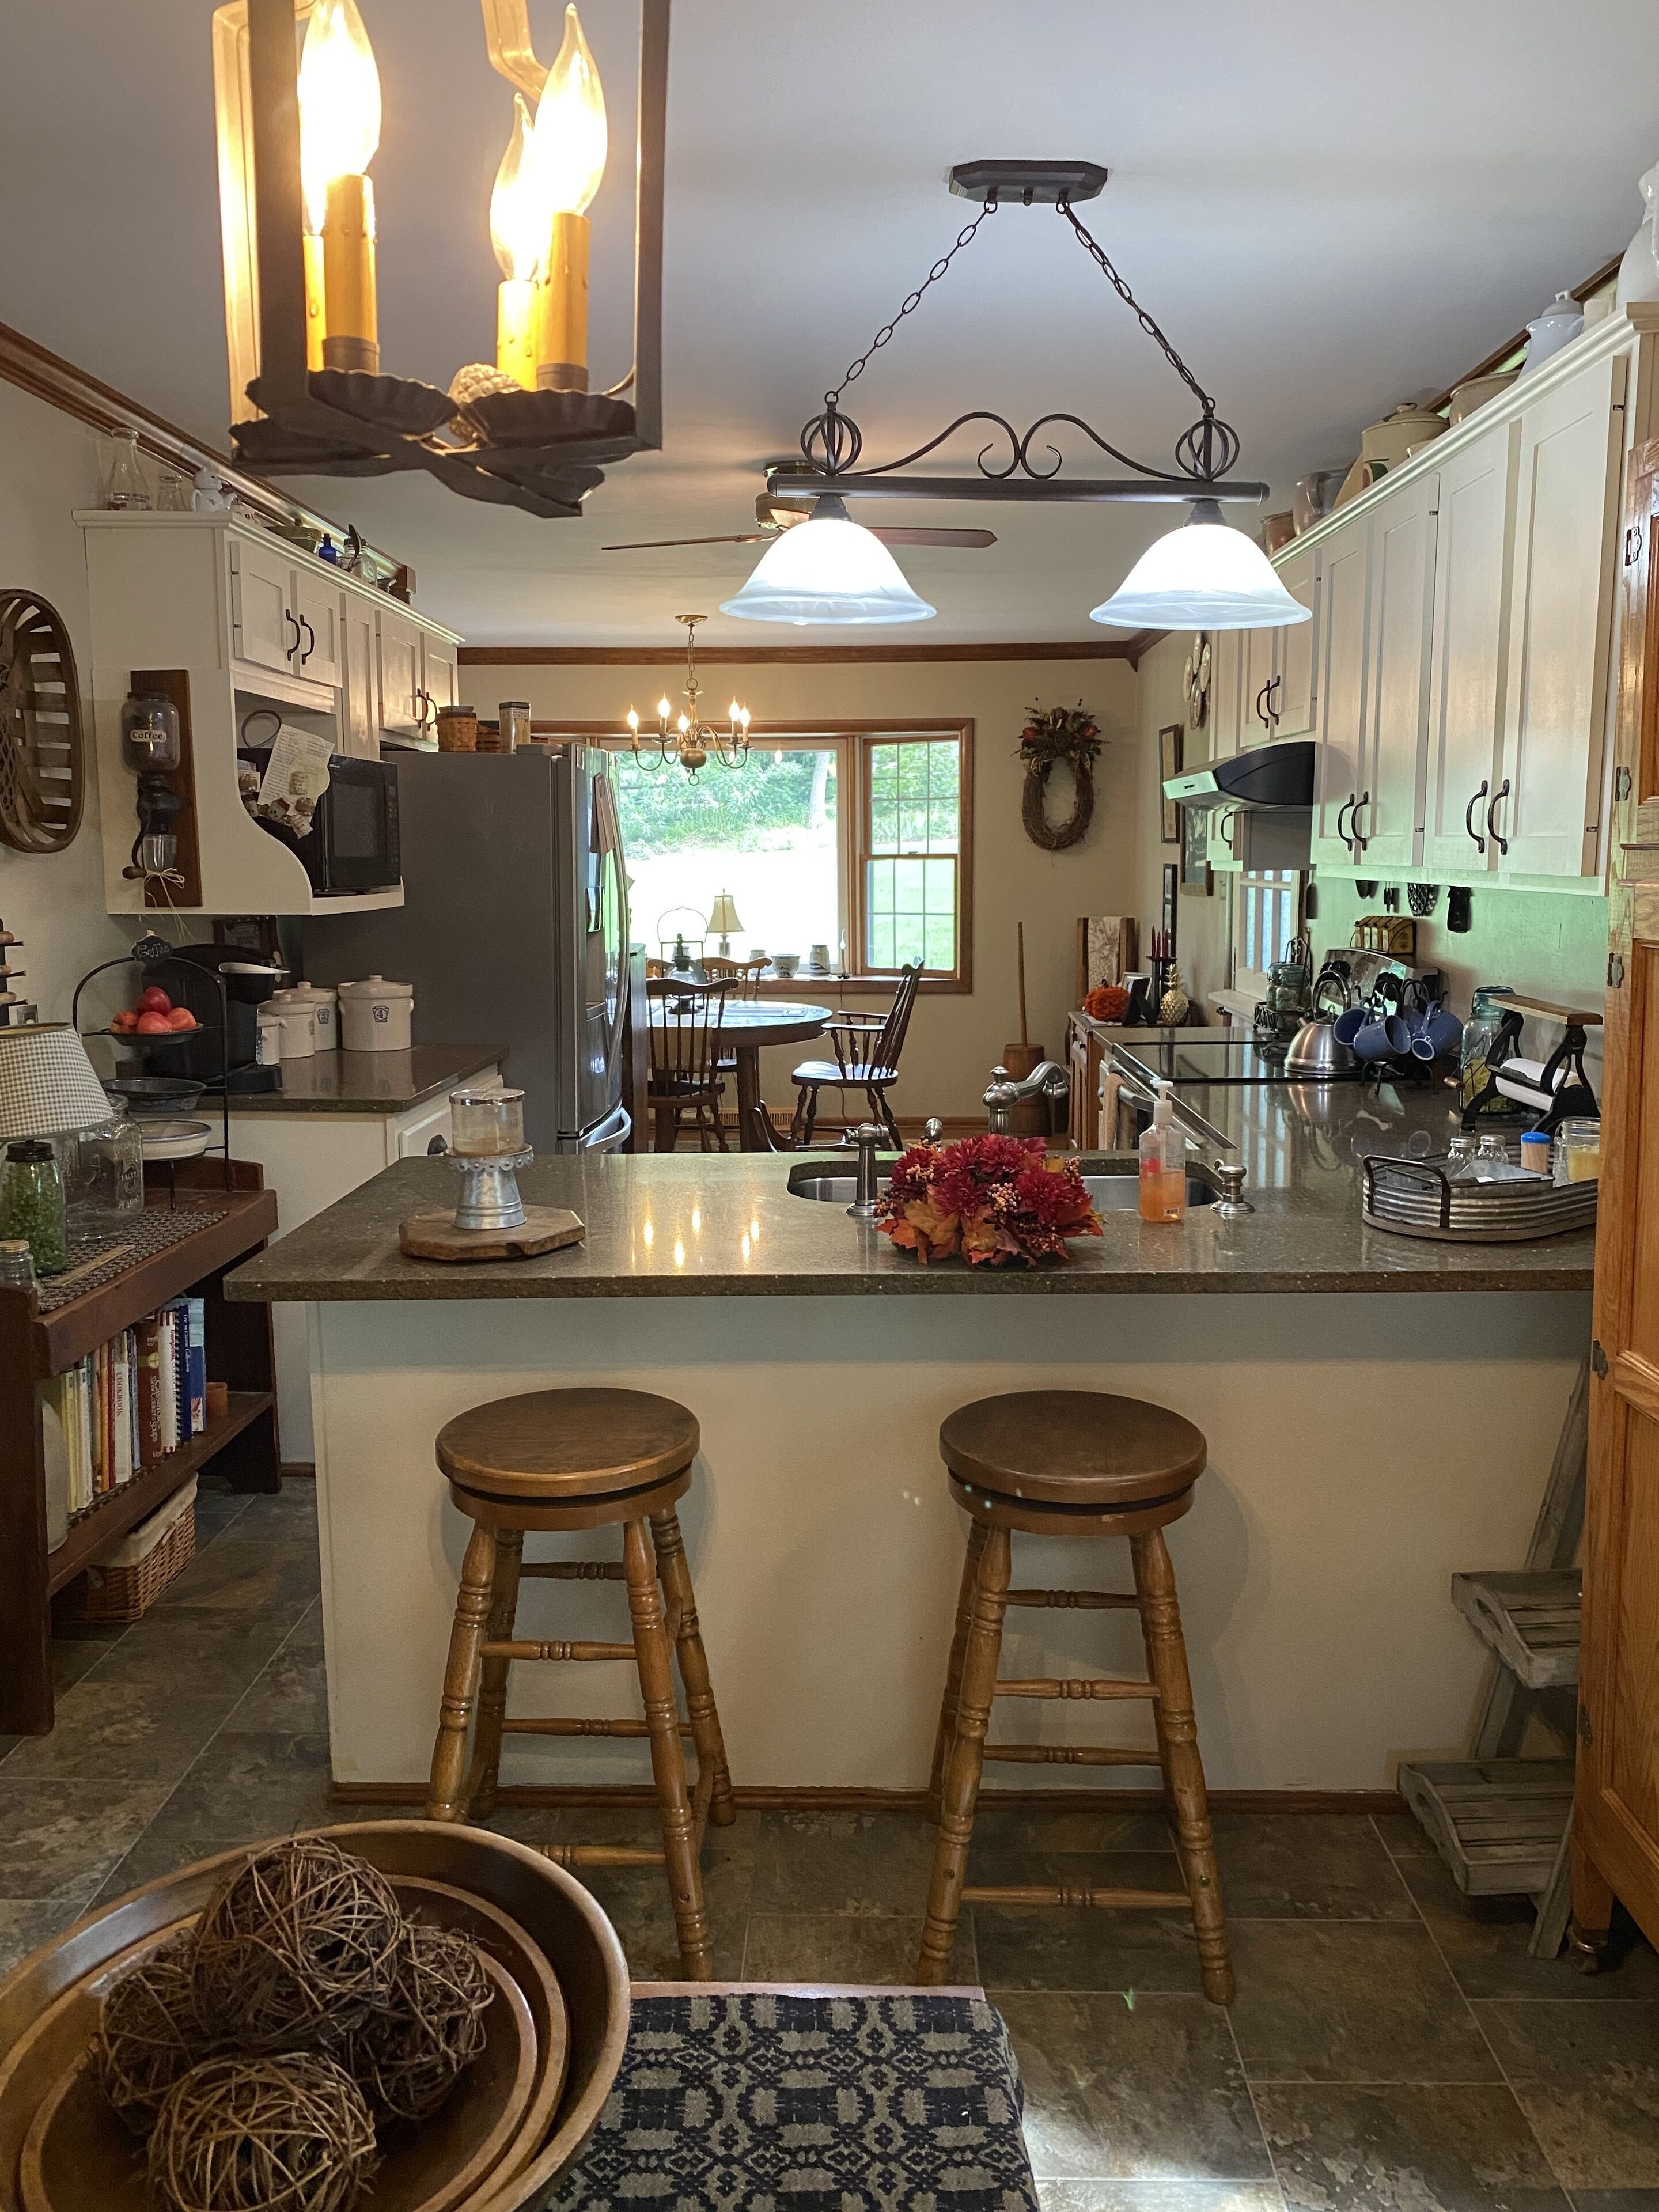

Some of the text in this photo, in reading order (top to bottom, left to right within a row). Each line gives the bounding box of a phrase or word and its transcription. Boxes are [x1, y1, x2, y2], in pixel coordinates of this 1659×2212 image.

[132, 732, 163, 740] Coffee
[138, 942, 171, 958] Coffee
[376, 1009, 384, 1018] 4
[149, 1421, 158, 1442] Soups
